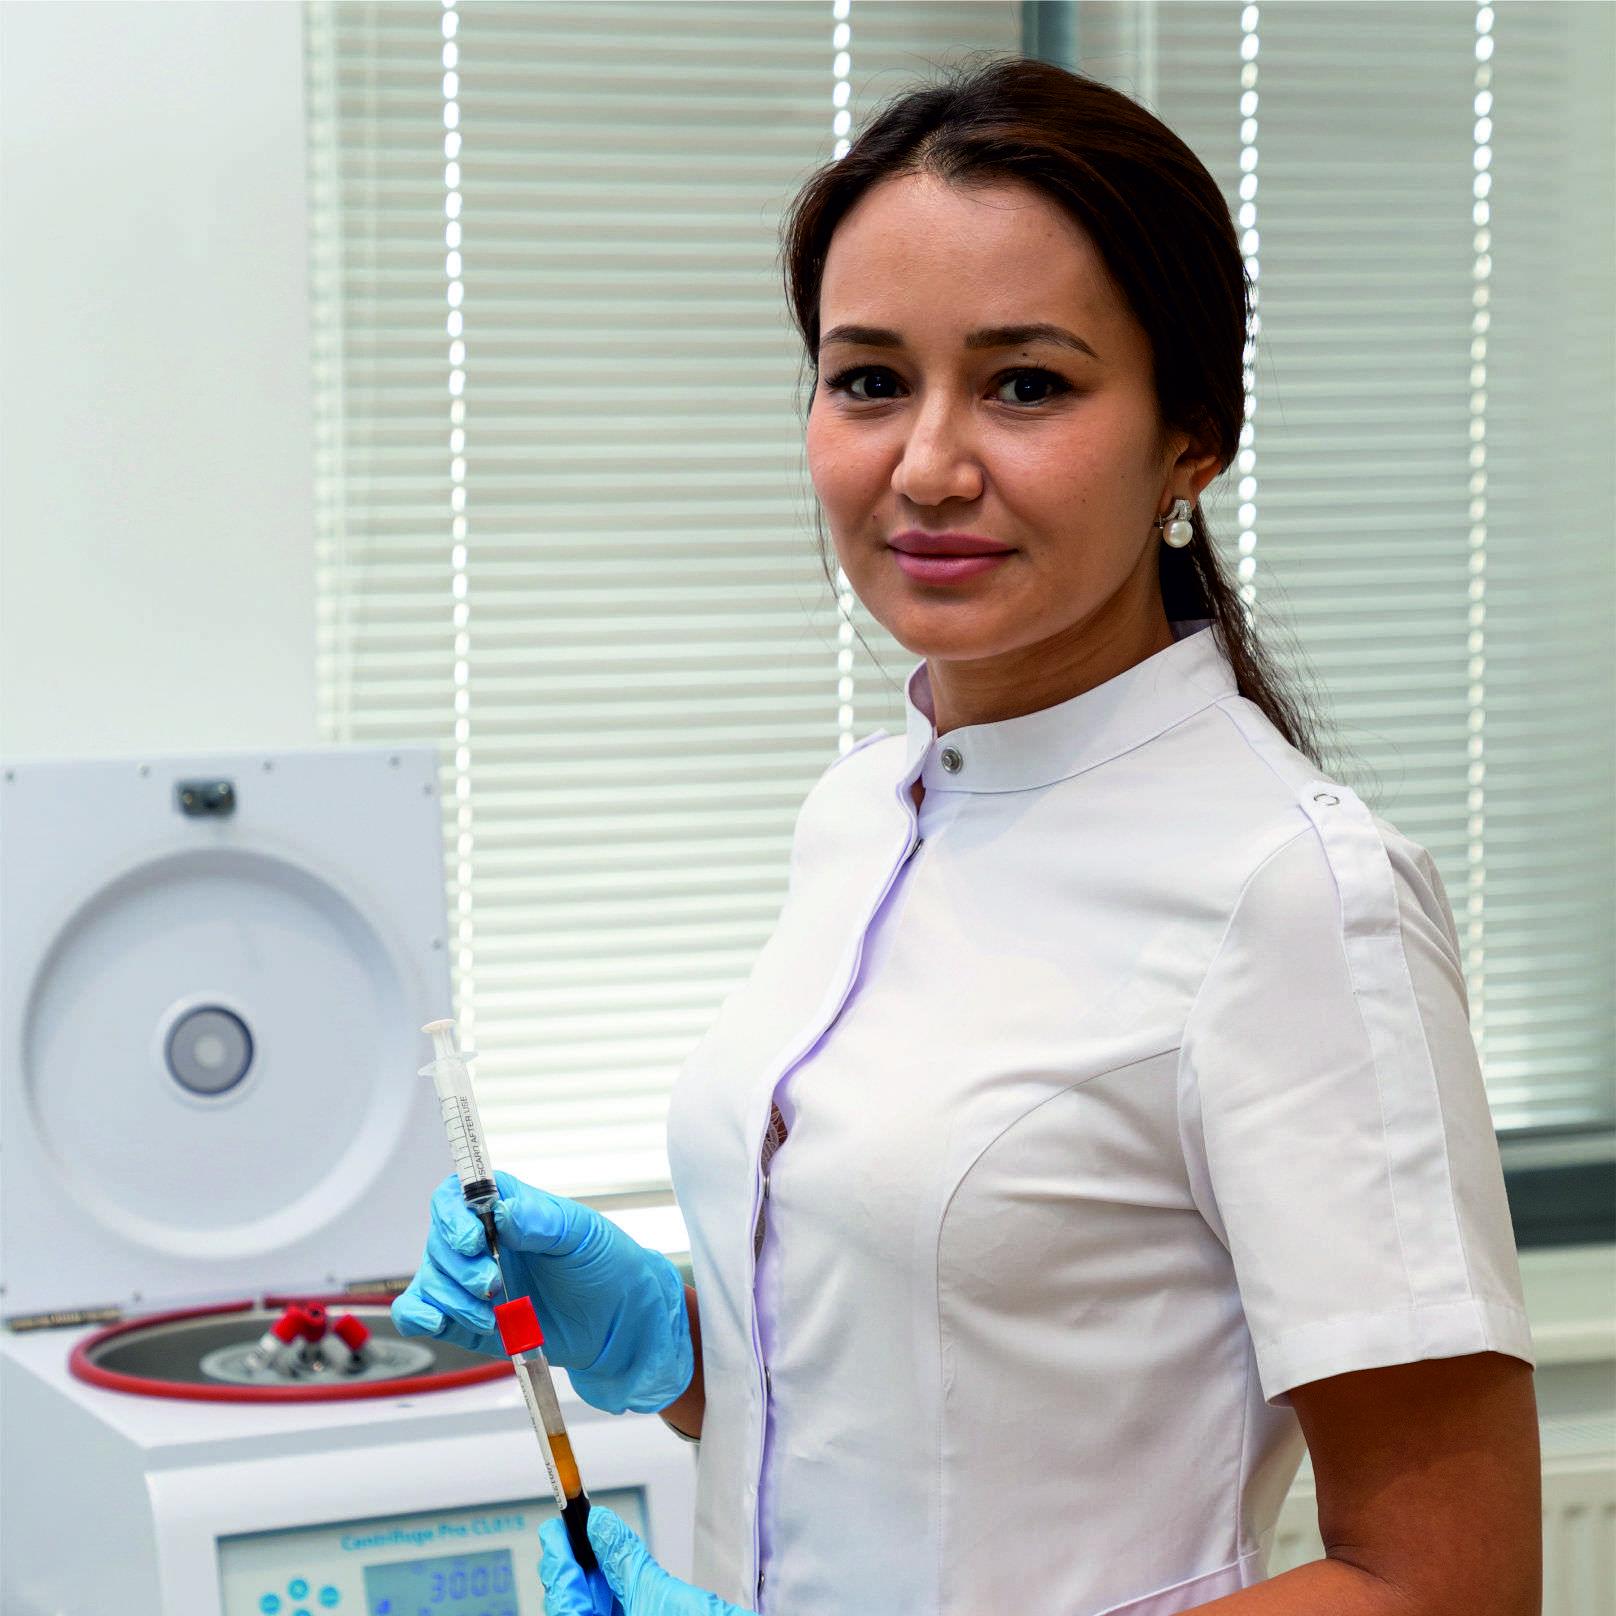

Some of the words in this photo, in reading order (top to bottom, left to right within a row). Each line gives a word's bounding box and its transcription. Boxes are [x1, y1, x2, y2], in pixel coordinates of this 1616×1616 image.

[460, 1096, 471, 1114] USE
[466, 1115, 479, 1144] AFTER
[473, 1144, 487, 1181] ISCARD
[341, 1526, 434, 1550] Centrifuge
[430, 1565, 512, 1604] 3000
